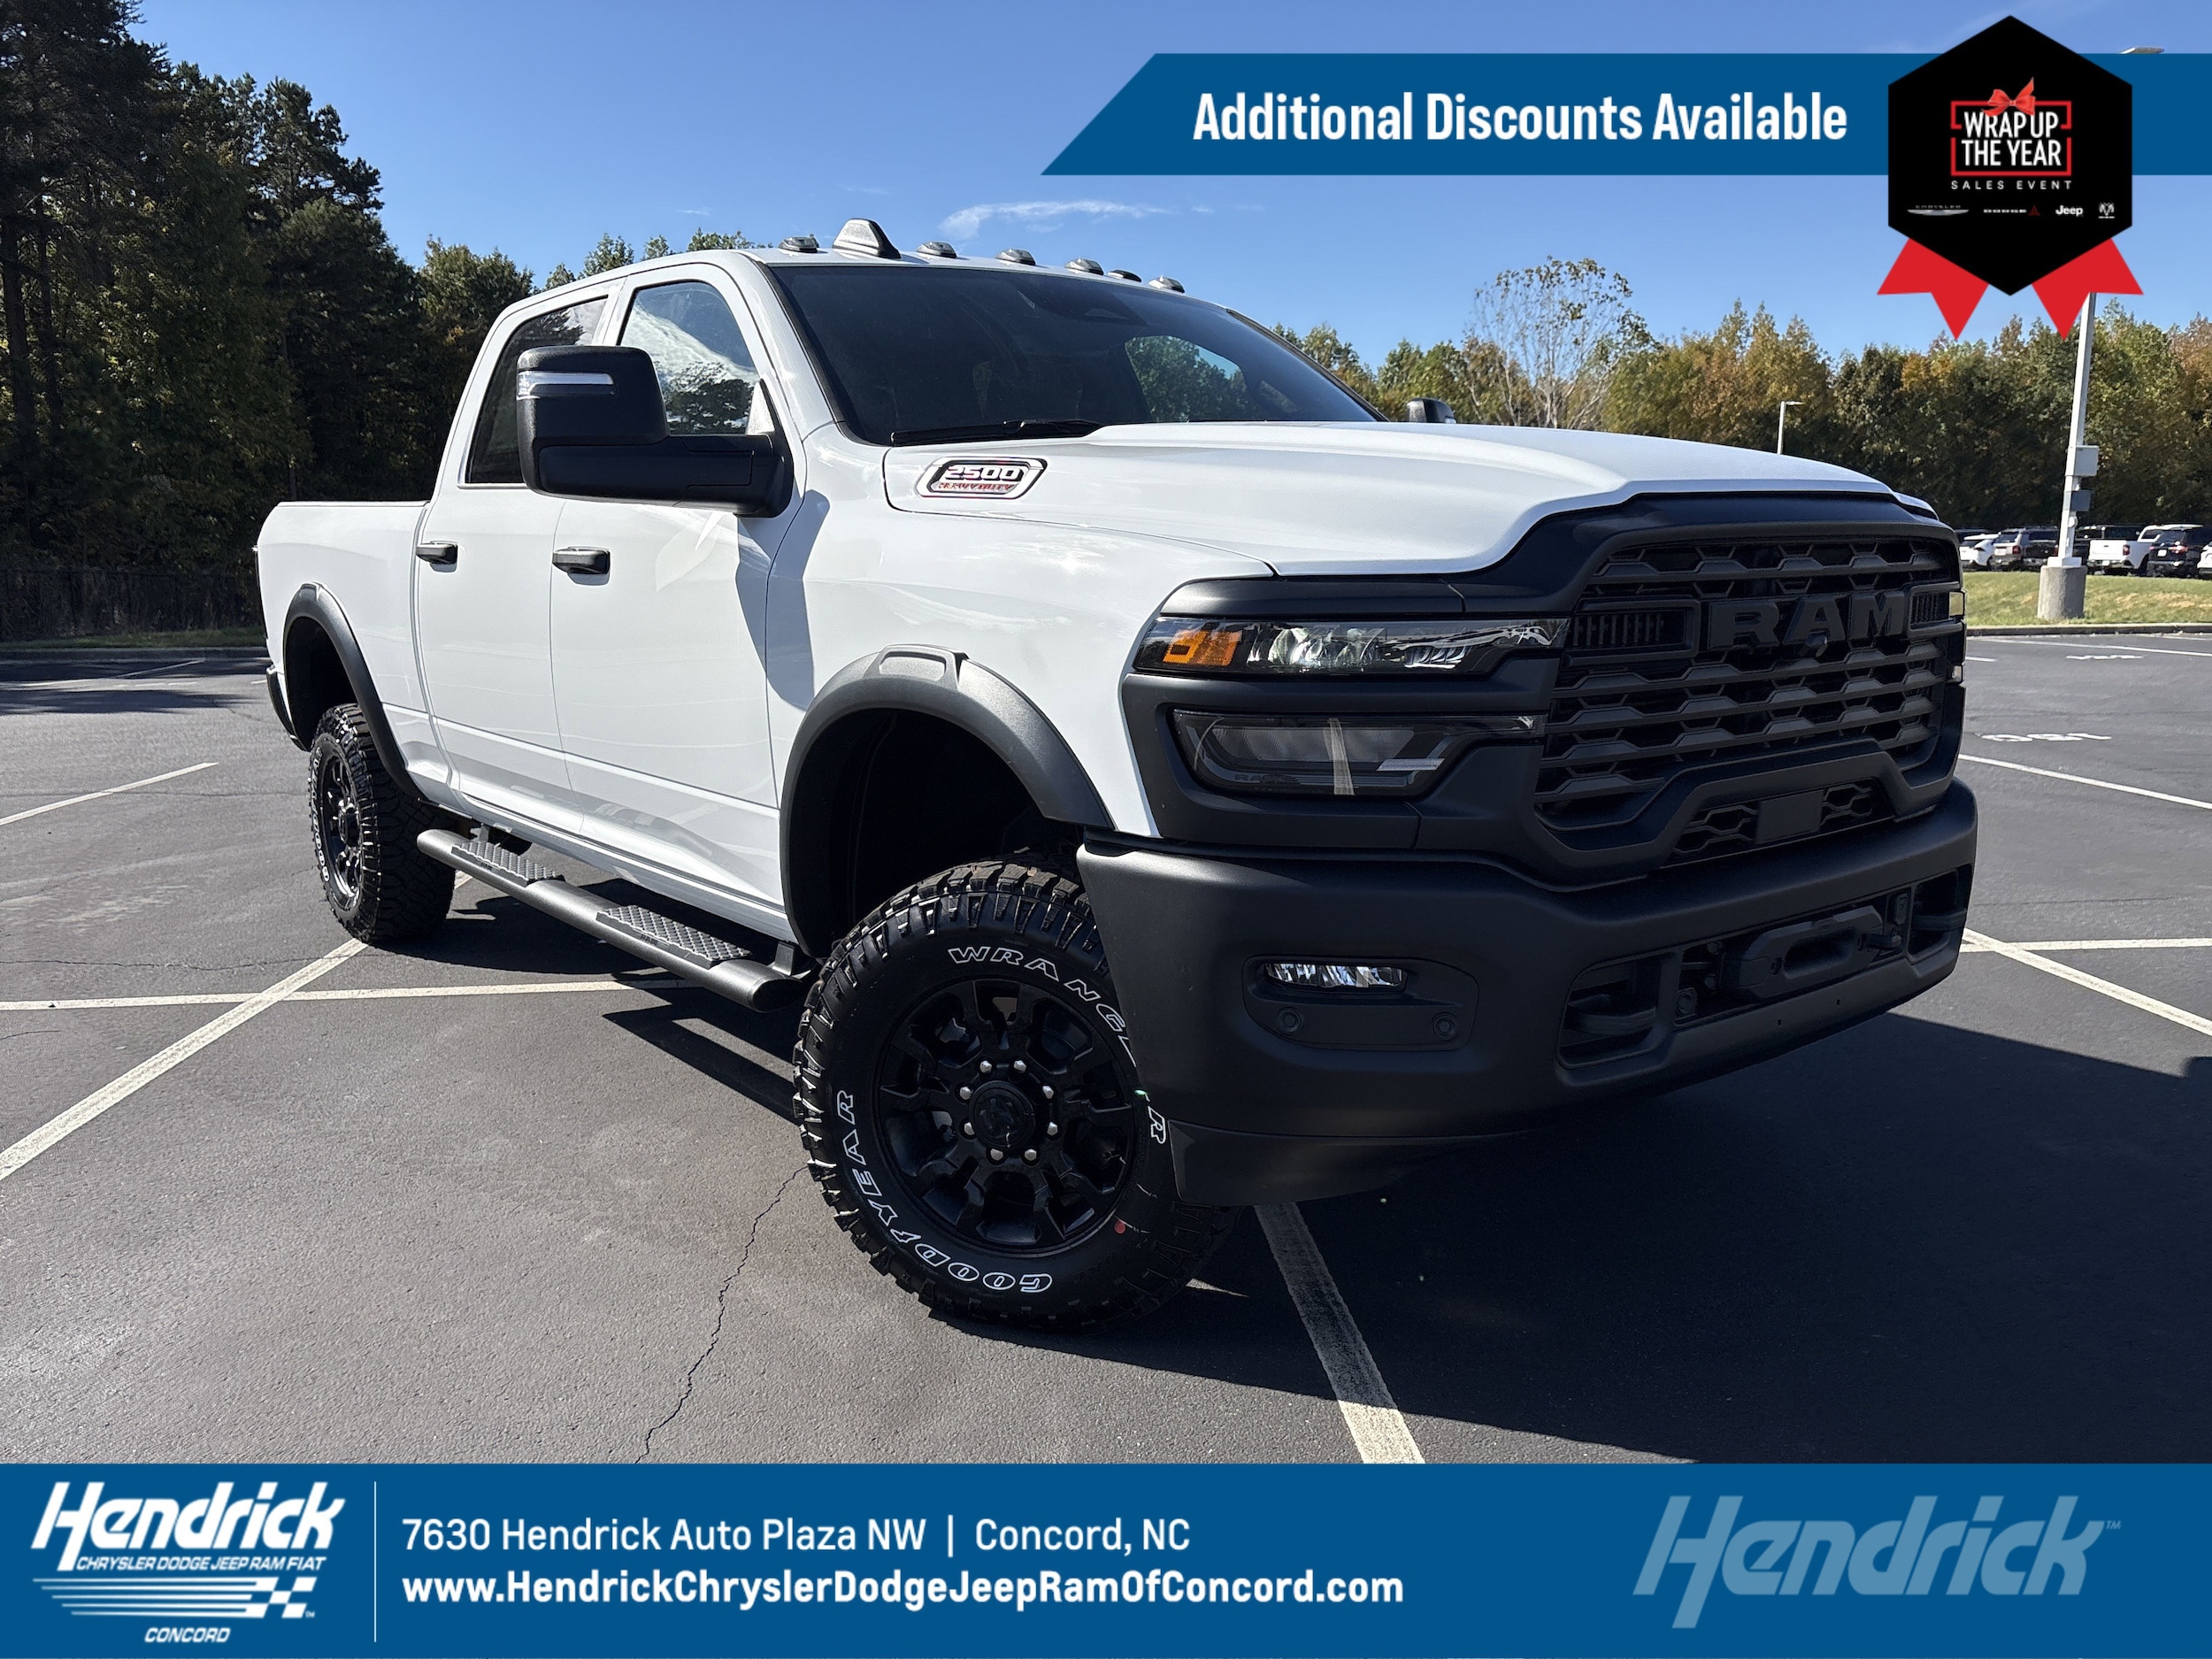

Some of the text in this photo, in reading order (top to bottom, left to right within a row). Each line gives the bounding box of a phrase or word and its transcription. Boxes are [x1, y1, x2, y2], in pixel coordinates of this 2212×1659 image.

[944, 465, 1022, 481] 2500
[1707, 590, 1906, 649] RAM
[948, 946, 1166, 1144] WRANGR
[836, 1089, 1053, 1294] GOODYEAR
